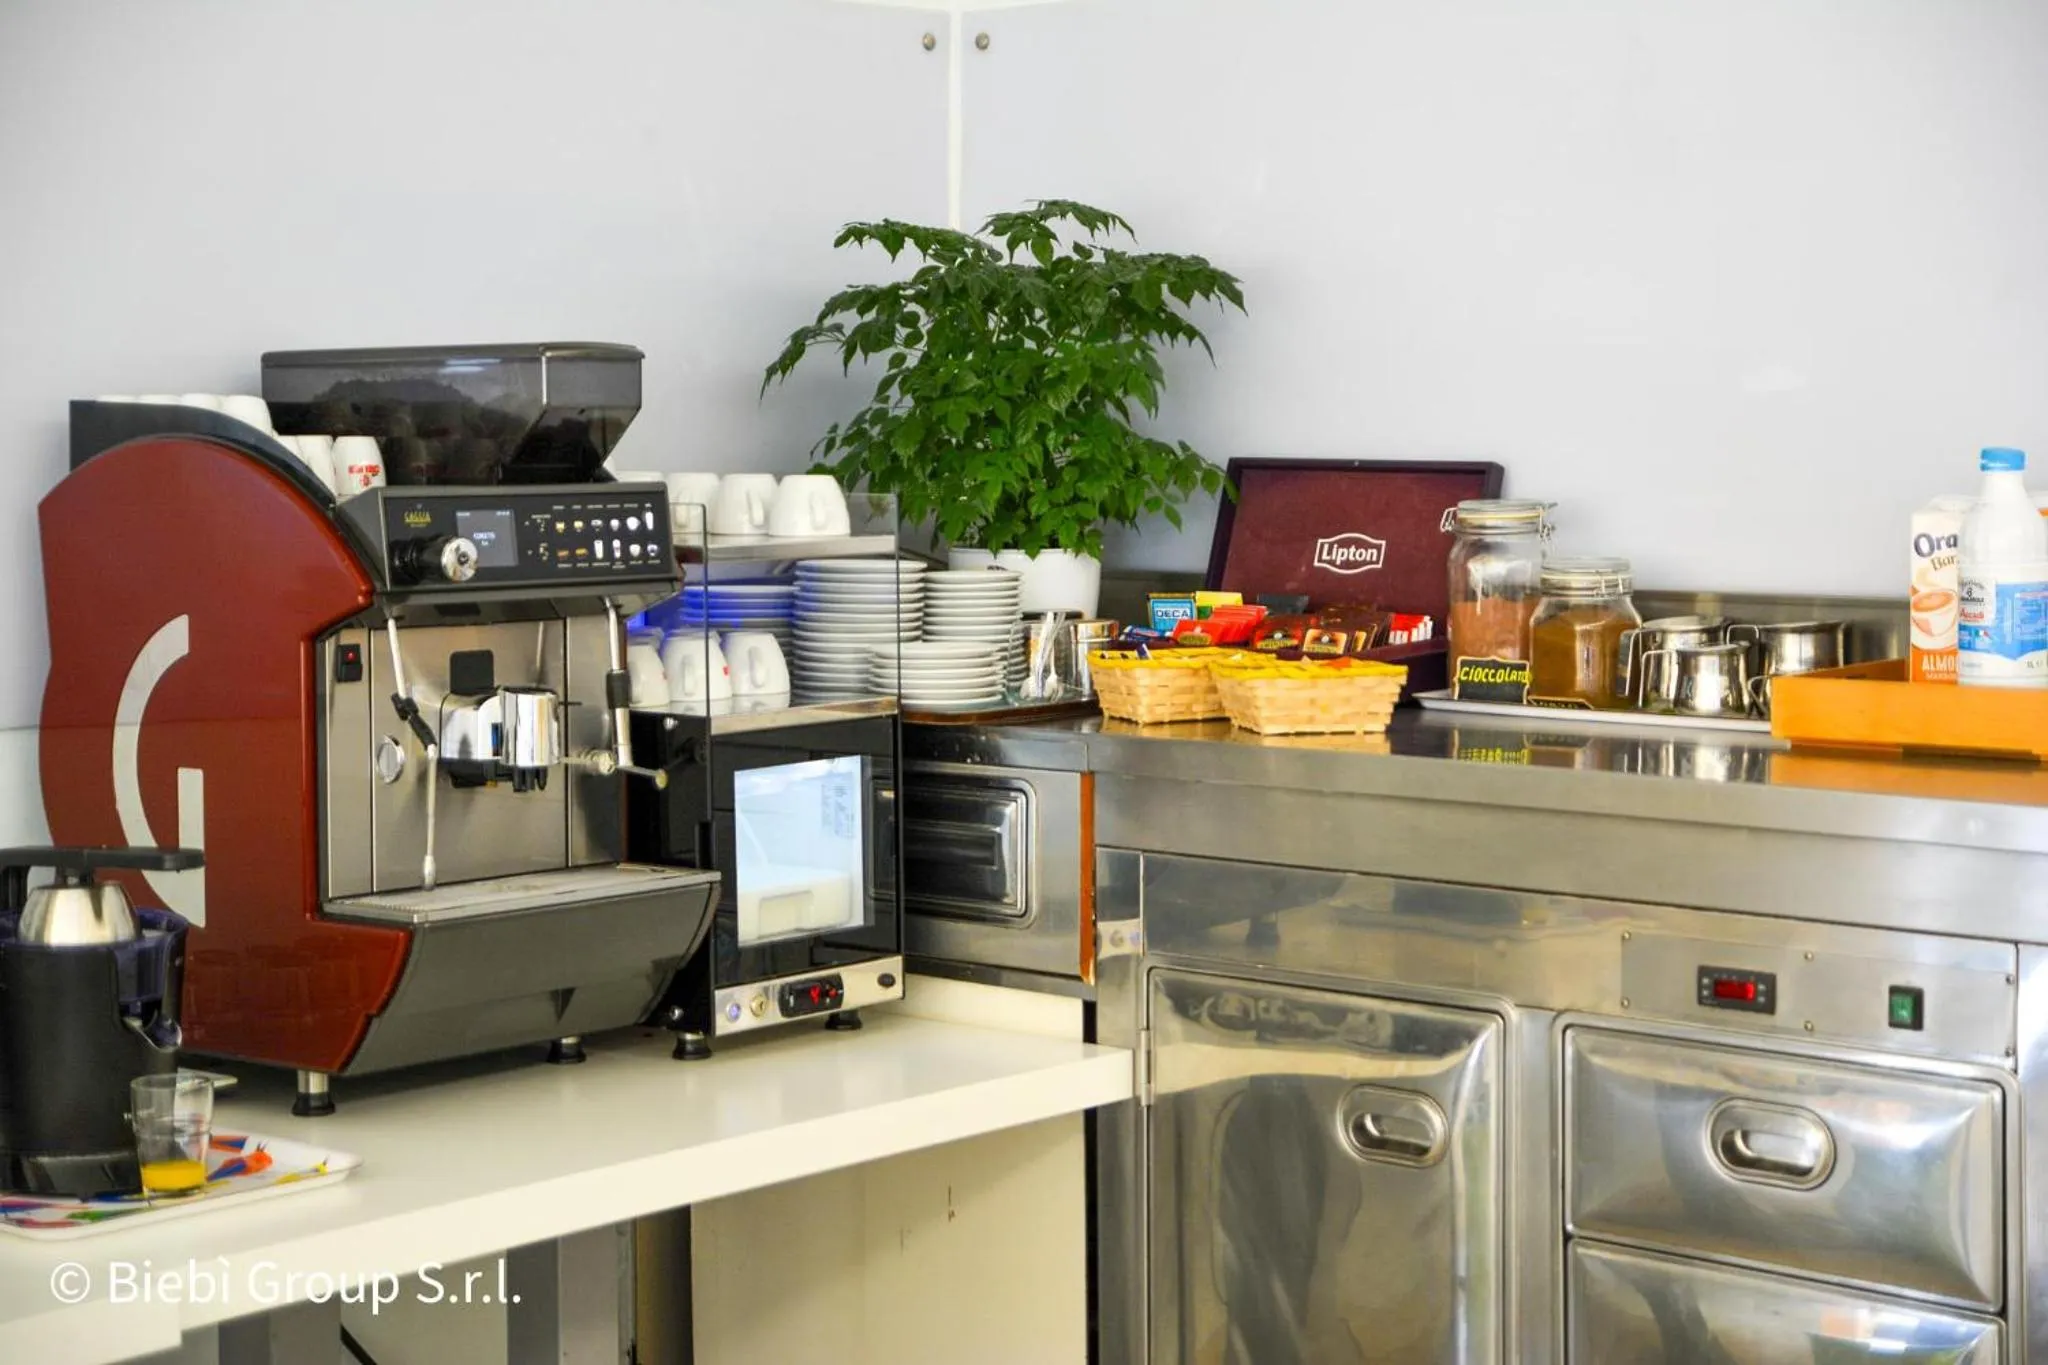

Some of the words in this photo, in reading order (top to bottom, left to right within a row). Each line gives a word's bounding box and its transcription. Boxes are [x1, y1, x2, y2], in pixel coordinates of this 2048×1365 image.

[1321, 543, 1378, 565] Lipton
[1155, 607, 1189, 618] DECA
[1922, 654, 1958, 673] ALMO
